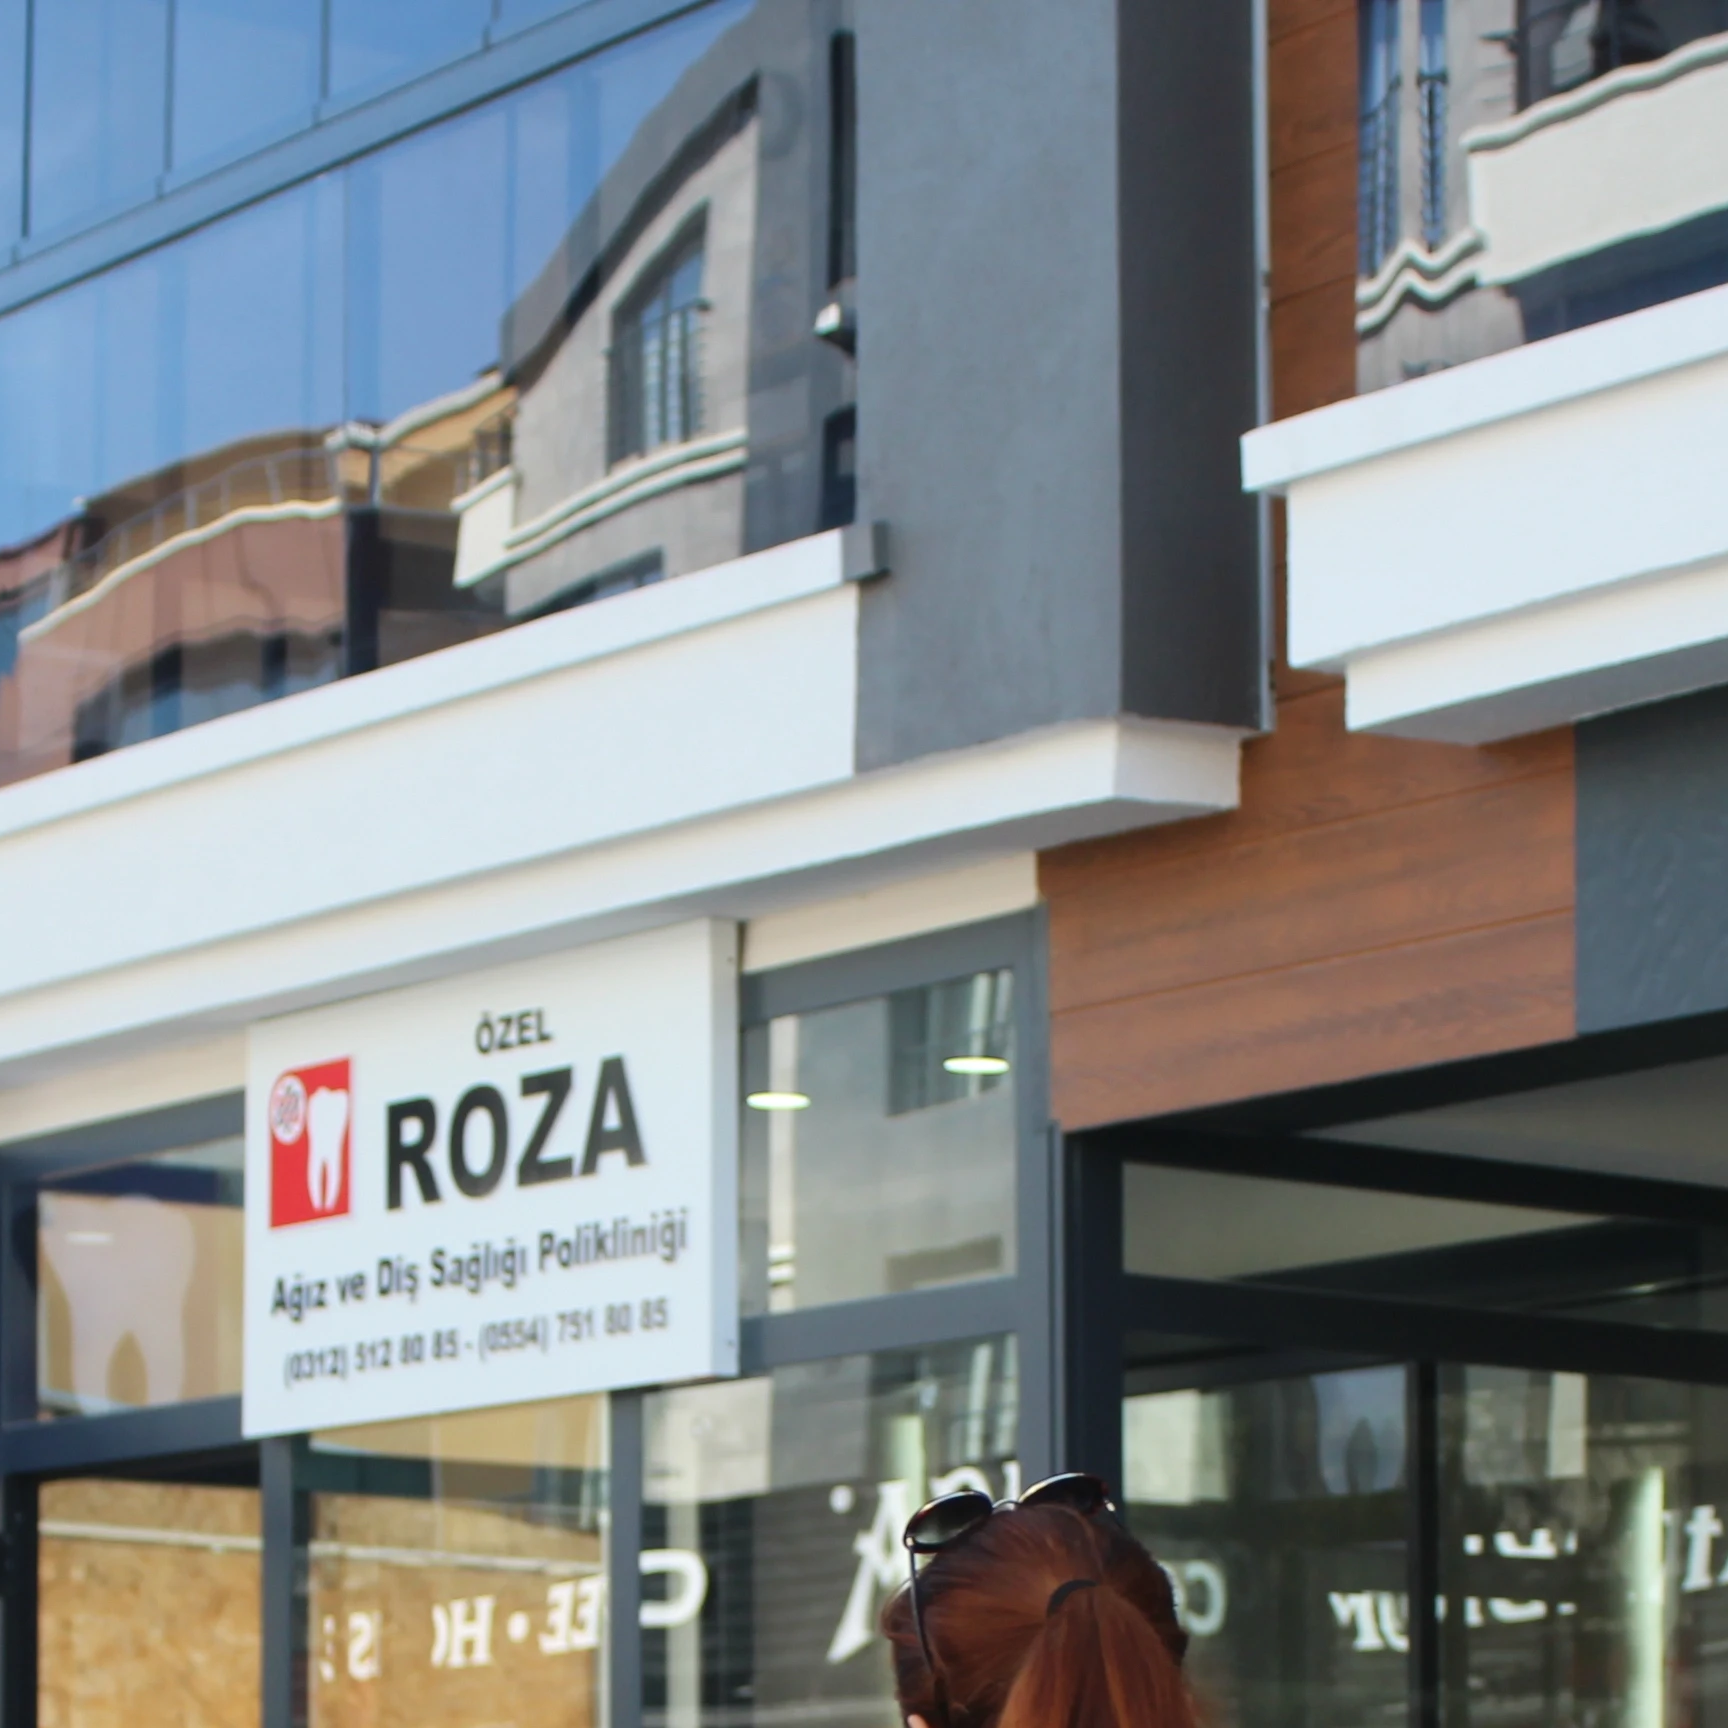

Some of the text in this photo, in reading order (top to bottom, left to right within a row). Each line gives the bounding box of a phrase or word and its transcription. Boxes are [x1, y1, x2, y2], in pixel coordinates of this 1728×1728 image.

[475, 1008, 553, 1055] ÖZEL
[384, 1053, 648, 1212] ROZA
[270, 1207, 688, 1325] Ağız ve Diş Sağlığı Polikliniği
[284, 1345, 348, 1391] (0312)
